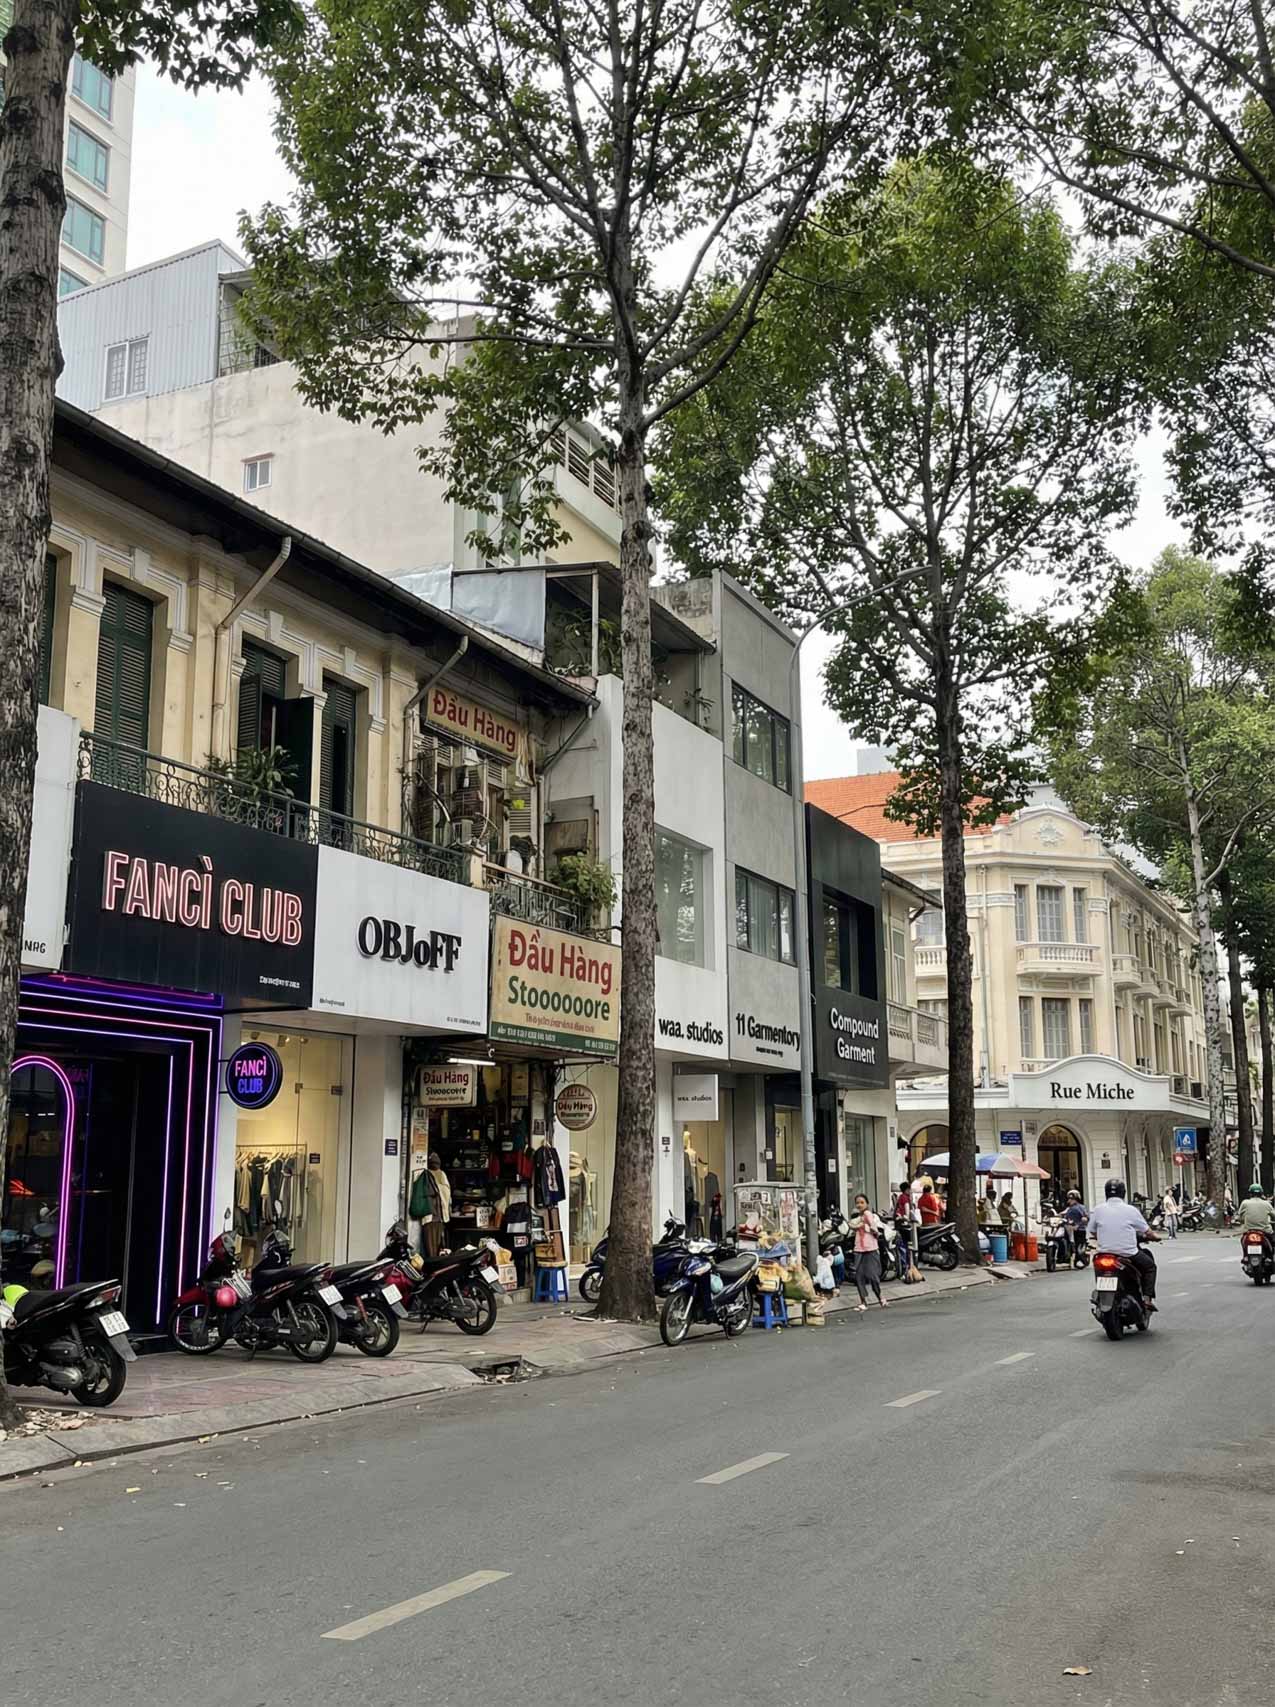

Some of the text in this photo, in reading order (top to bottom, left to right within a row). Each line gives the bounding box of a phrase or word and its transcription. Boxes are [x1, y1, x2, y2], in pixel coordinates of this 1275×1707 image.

[433, 689, 516, 752] Đầu Hàng
[102, 850, 303, 946] FANCÌ CLUB
[508, 929, 612, 995] Đầu Hàng
[508, 976, 610, 1021] Stoooooore
[659, 1018, 724, 1045] waa. studios
[747, 1015, 801, 1052] Garmentory
[830, 1007, 879, 1039] Compound
[235, 1056, 267, 1077] FANCÌ
[837, 1036, 876, 1065] Garment
[238, 1078, 263, 1094] CLUB
[1050, 1082, 1135, 1100] Rue Miche
